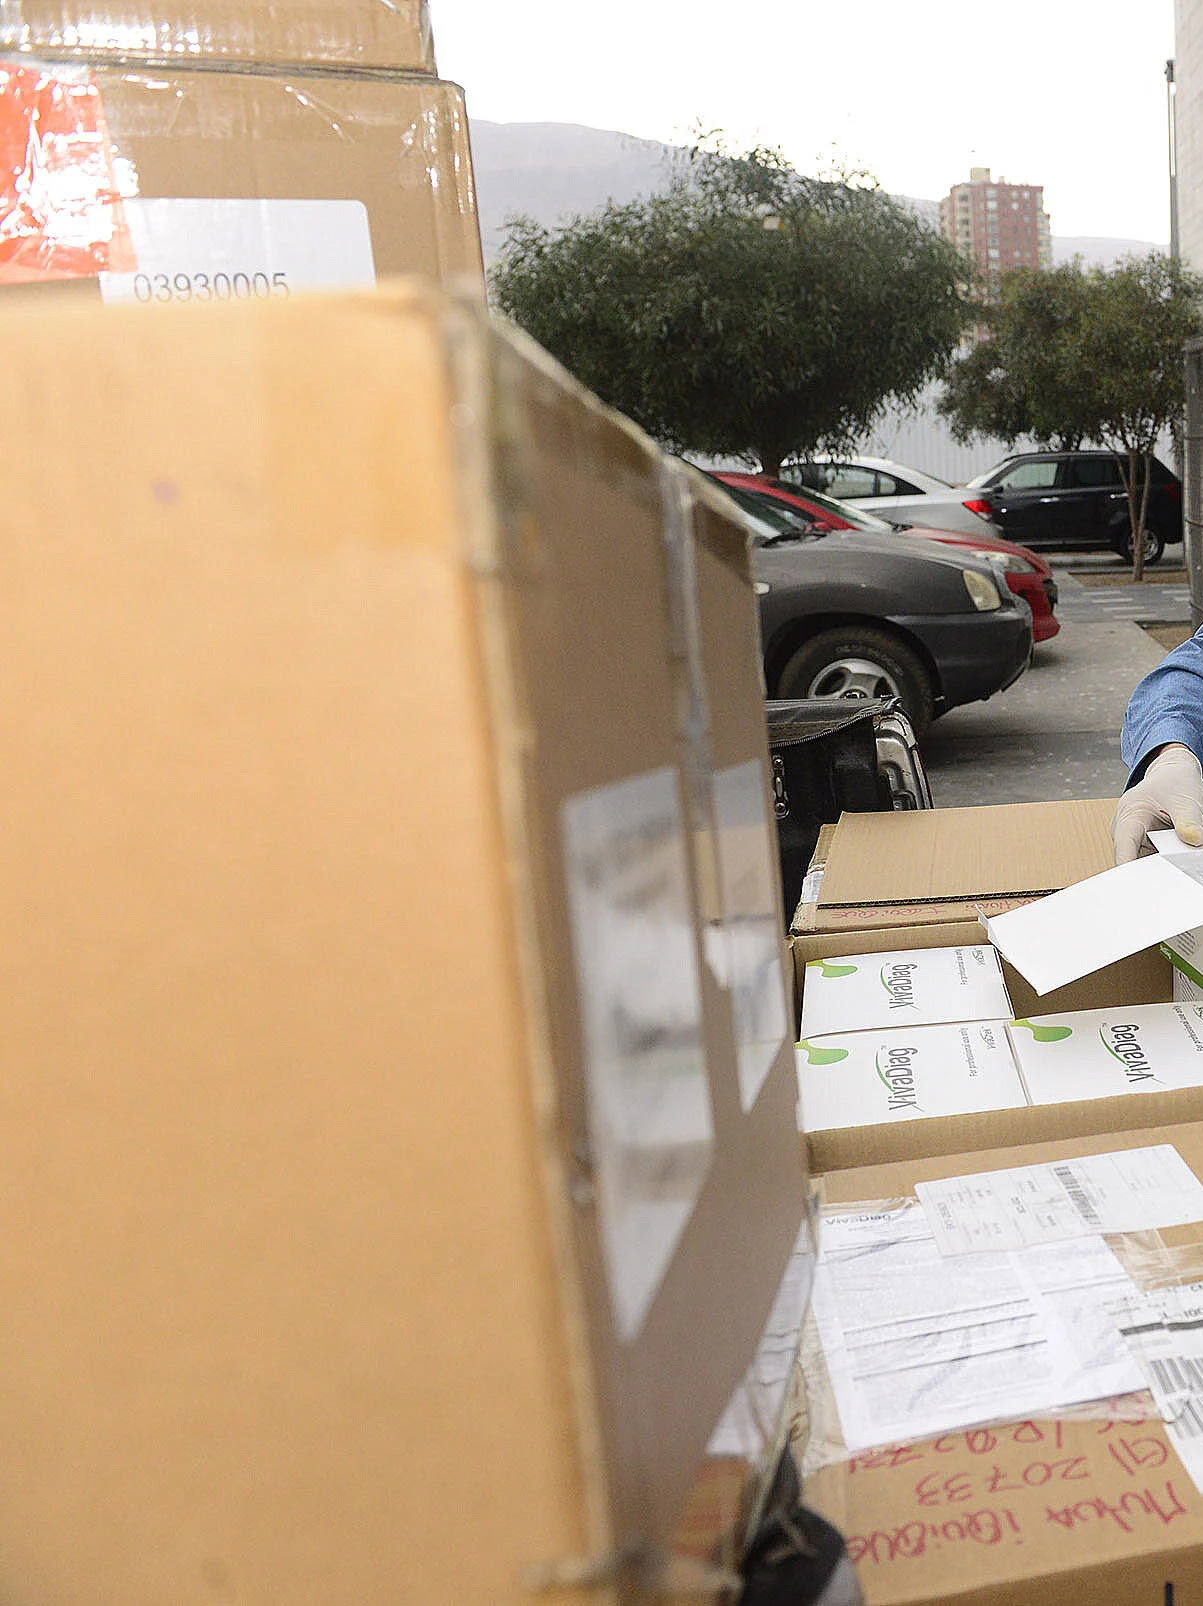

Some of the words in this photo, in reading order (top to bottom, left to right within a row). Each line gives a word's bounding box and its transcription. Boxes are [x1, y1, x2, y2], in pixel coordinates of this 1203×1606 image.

[134, 272, 290, 303] 03930005
[888, 963, 918, 1010] VivaDiag
[885, 1047, 918, 1111] VivaDiag
[1110, 1023, 1155, 1083] VivaDiag
